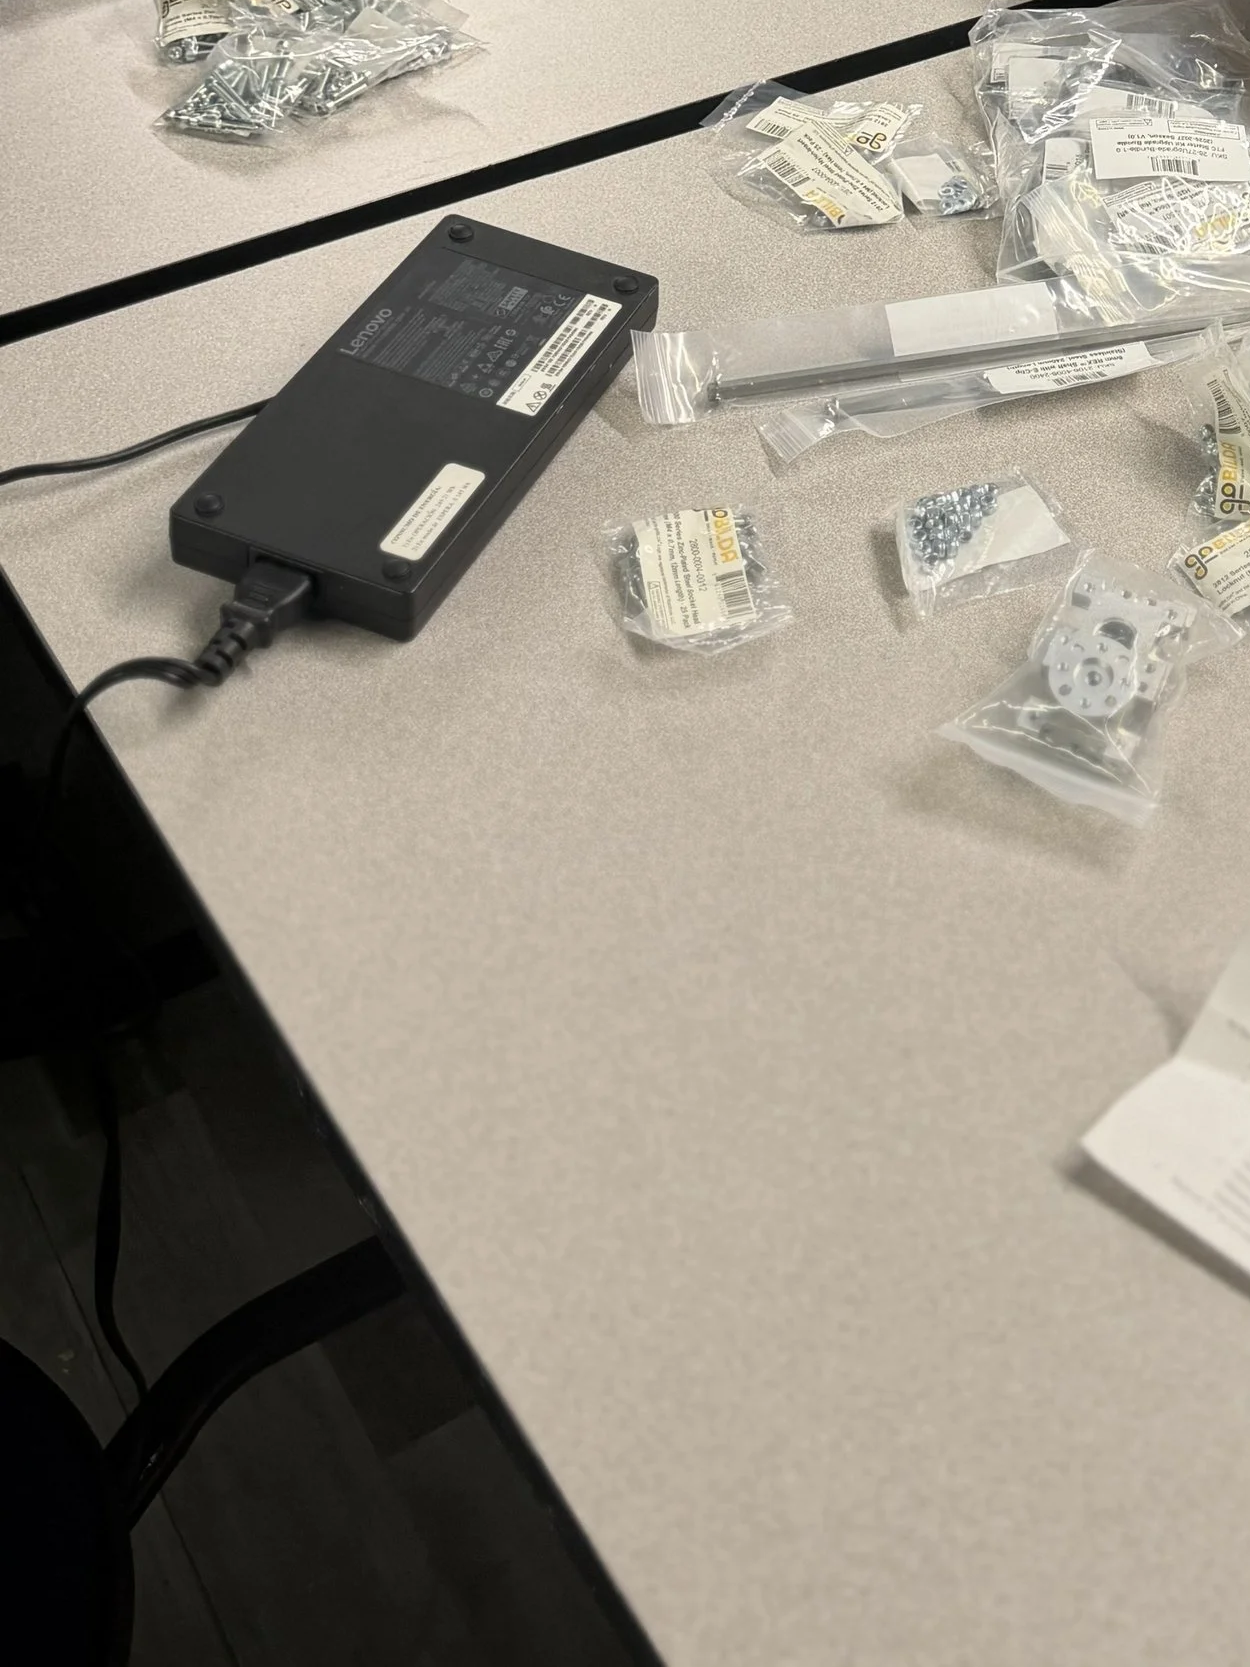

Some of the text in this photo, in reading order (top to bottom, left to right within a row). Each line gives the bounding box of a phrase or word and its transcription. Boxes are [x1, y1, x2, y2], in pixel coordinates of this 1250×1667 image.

[1126, 132, 1145, 140] V1.0)
[1174, 140, 1185, 148] Kit
[1185, 141, 1209, 151] Starter
[338, 304, 394, 356] Lenovo
[1039, 363, 1056, 372] with
[1056, 359, 1078, 371] Shaft
[672, 519, 685, 541] Series
[1215, 572, 1246, 596] Locknut
[685, 587, 698, 610] Socket
[680, 613, 691, 629] Pack
[690, 608, 701, 625] Head
